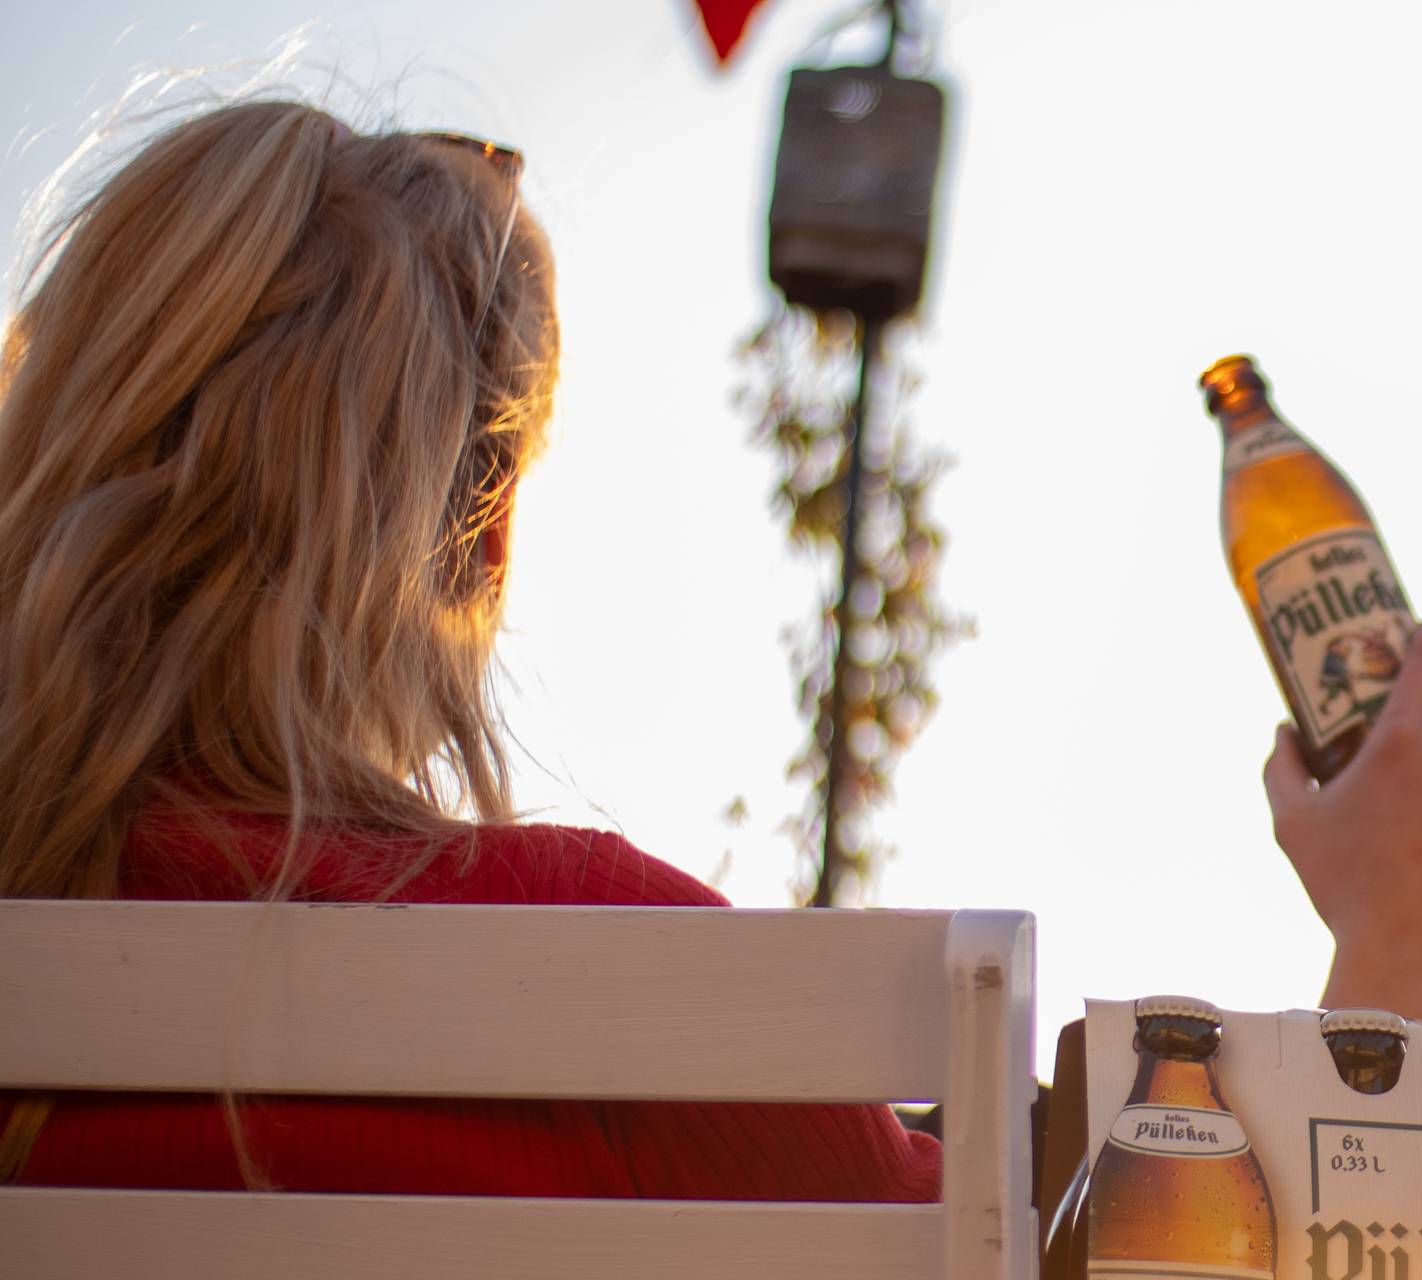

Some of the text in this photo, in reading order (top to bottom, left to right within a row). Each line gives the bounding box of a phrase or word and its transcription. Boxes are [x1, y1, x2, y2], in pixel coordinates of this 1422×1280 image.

[1134, 1121, 1219, 1143] Pülleken
[1342, 1134, 1364, 1151] 6x
[1331, 1154, 1386, 1173] 0.33 L
